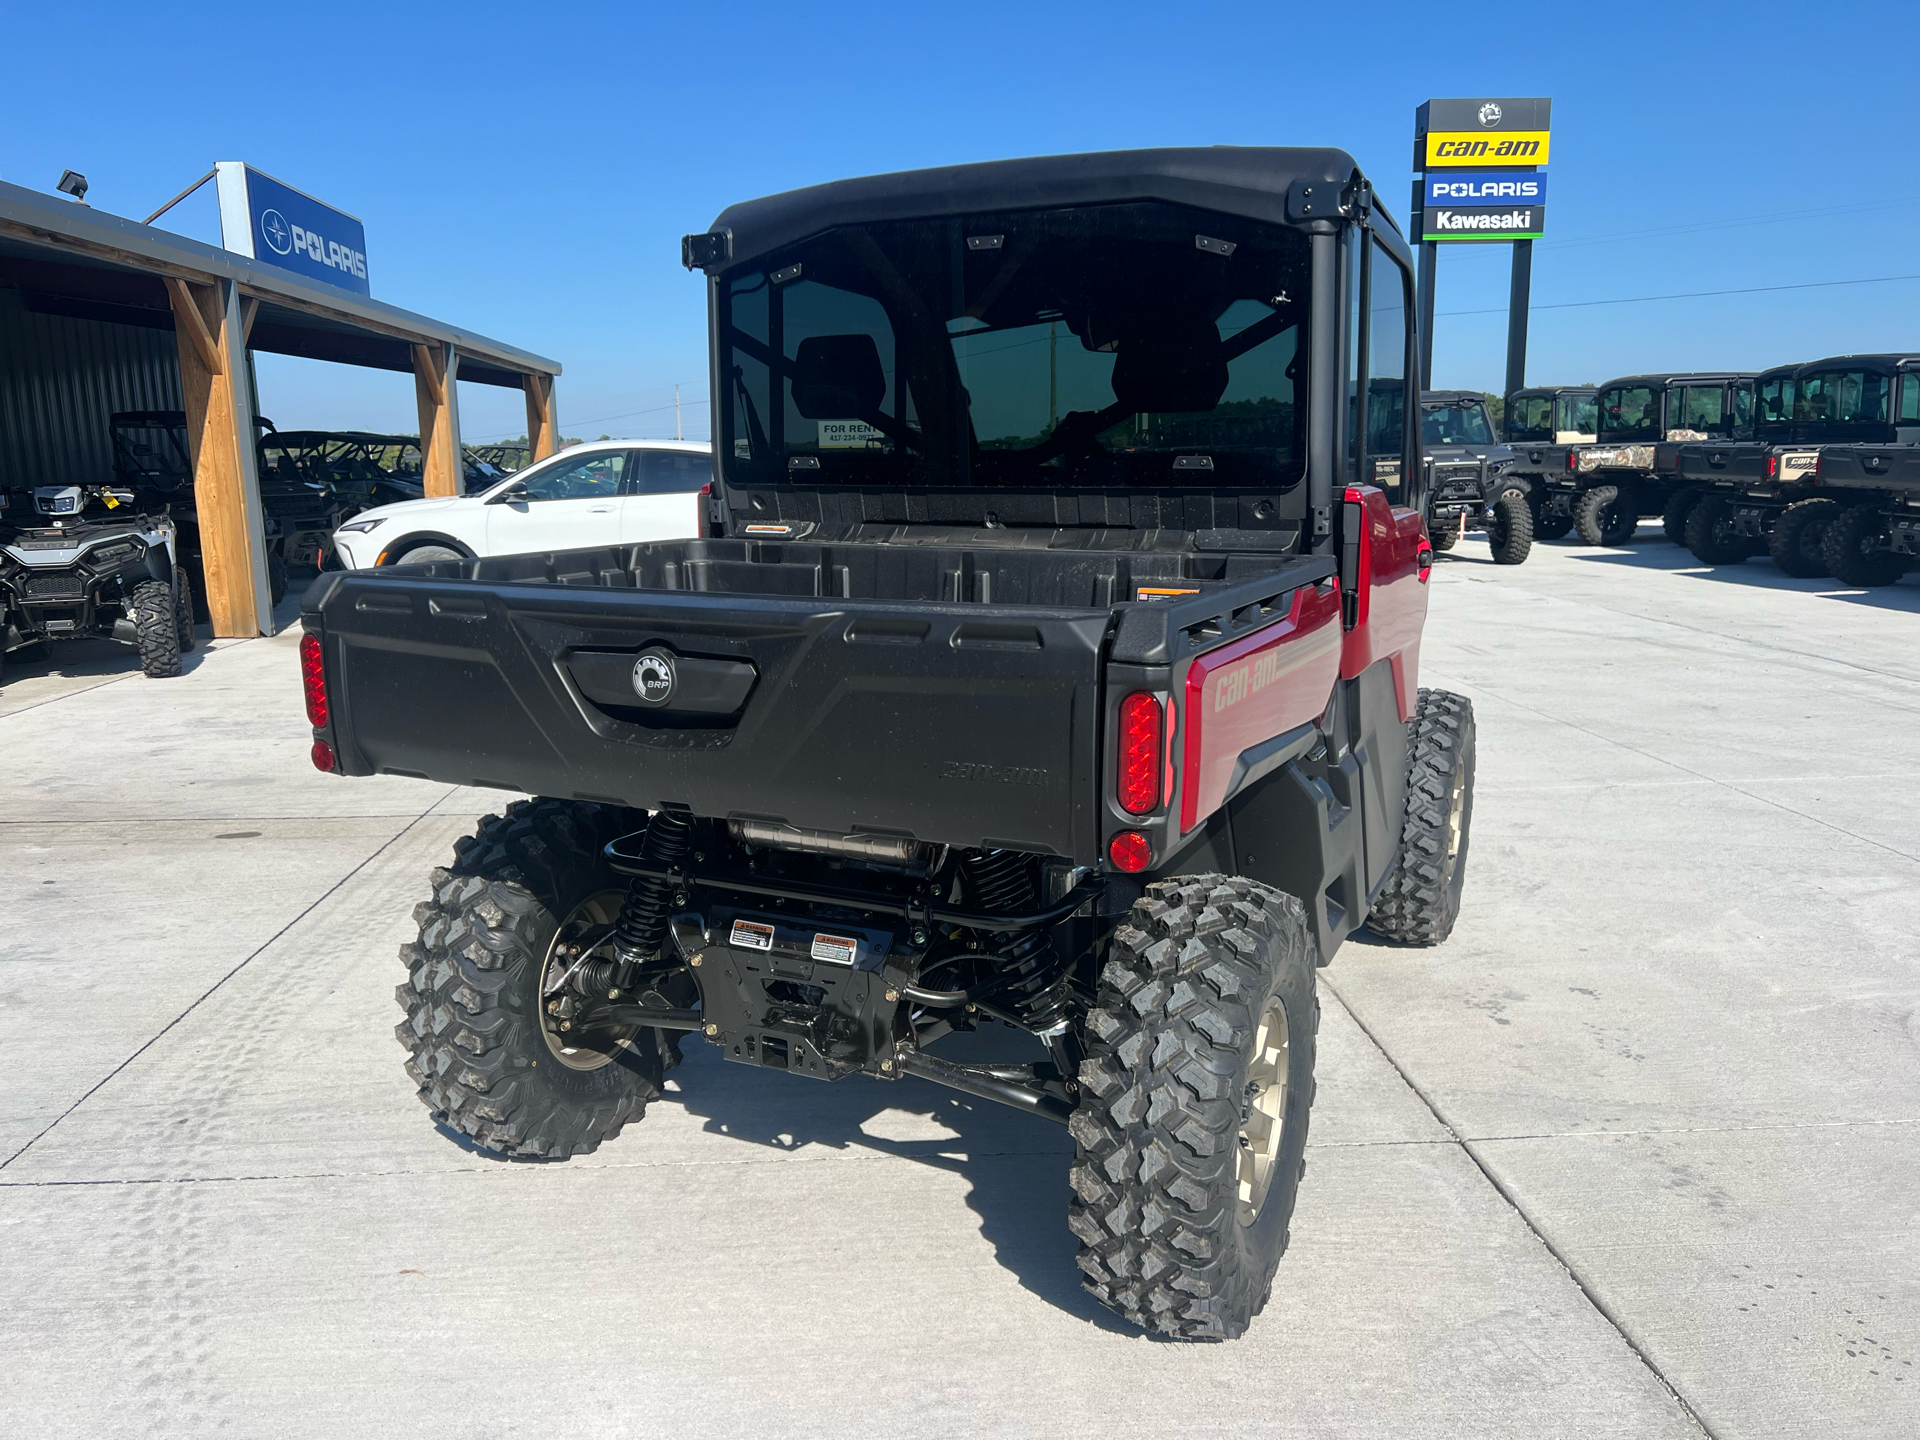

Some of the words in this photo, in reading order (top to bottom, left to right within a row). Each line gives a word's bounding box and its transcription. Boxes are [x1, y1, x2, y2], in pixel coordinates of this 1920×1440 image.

[1436, 140, 1540, 157] can-am
[1432, 182, 1538, 197] POLARIS
[1436, 211, 1531, 229] Kawasaki
[291, 223, 367, 280] POLARIS
[824, 424, 846, 433] FOR
[1790, 457, 1817, 465] can-a
[647, 680, 669, 689] BRP
[1214, 651, 1278, 713] can-am
[940, 761, 1048, 786] can-am
[745, 924, 768, 932] WARNING
[826, 938, 849, 946] WARNING
